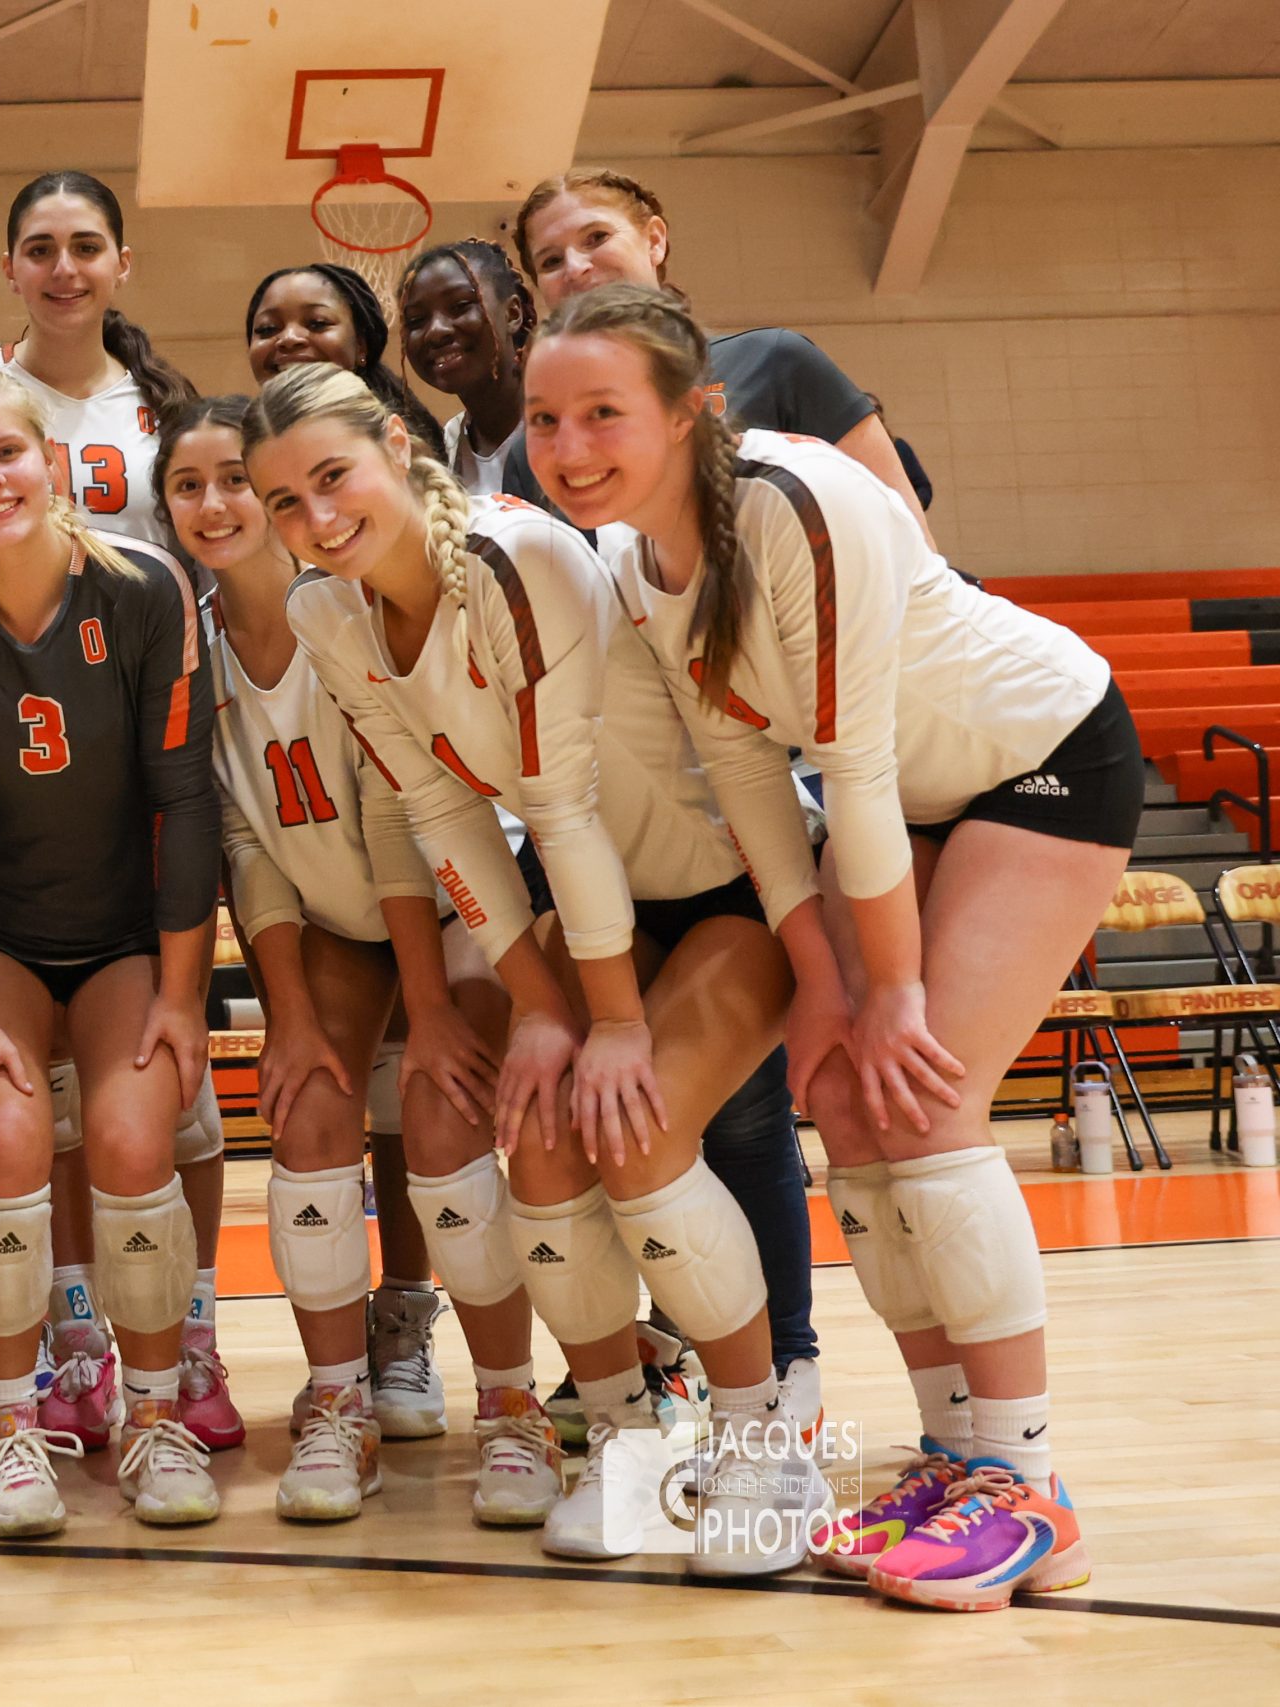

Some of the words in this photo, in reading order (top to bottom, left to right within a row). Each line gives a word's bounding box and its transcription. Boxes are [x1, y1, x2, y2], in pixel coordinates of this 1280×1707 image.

[18, 693, 71, 775] 3
[263, 737, 339, 828] 11
[1014, 783, 1069, 796] adidas
[433, 858, 488, 930] ORANGE
[1180, 990, 1274, 1010] PANTHERS
[292, 1217, 329, 1226] adidas
[436, 1217, 470, 1229] adidas
[122, 1244, 159, 1253] adidas
